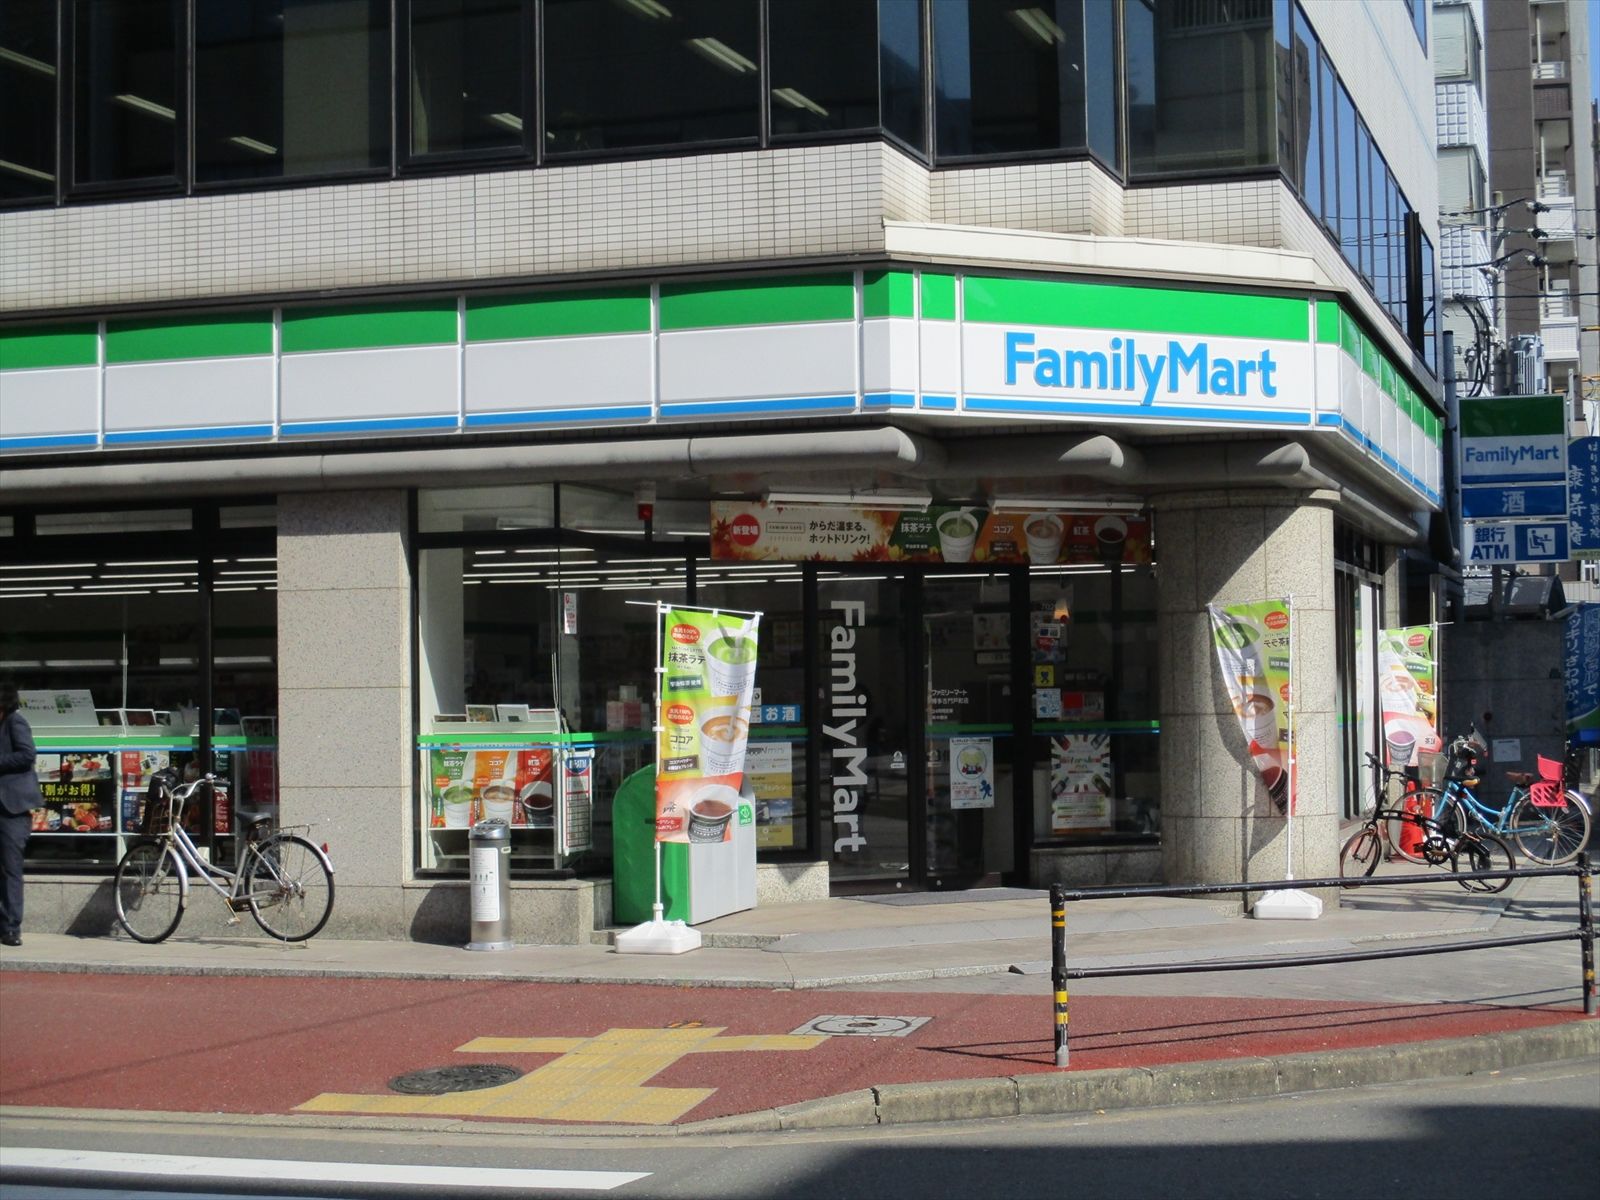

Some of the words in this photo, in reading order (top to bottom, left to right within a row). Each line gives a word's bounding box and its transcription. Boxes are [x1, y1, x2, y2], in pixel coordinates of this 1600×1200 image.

[1005, 331, 1277, 406] FamilyMart
[1465, 445, 1560, 465] FamilyMart
[1502, 491, 1526, 513] 酒
[732, 525, 759, 535] 新登場
[809, 521, 867, 532] からだ温まる、
[901, 522, 933, 533] 抹茶ラテ
[992, 525, 1015, 534] ココア
[1073, 526, 1089, 535] 紅茶
[1474, 527, 1506, 542] 銀行
[1470, 544, 1510, 560] ATM
[668, 652, 706, 665] 抹茶ラテ
[766, 707, 796, 721] お酒
[822, 600, 868, 853] FamilyMart
[670, 735, 693, 744] ココア
[40, 783, 96, 796] 割がお得!
